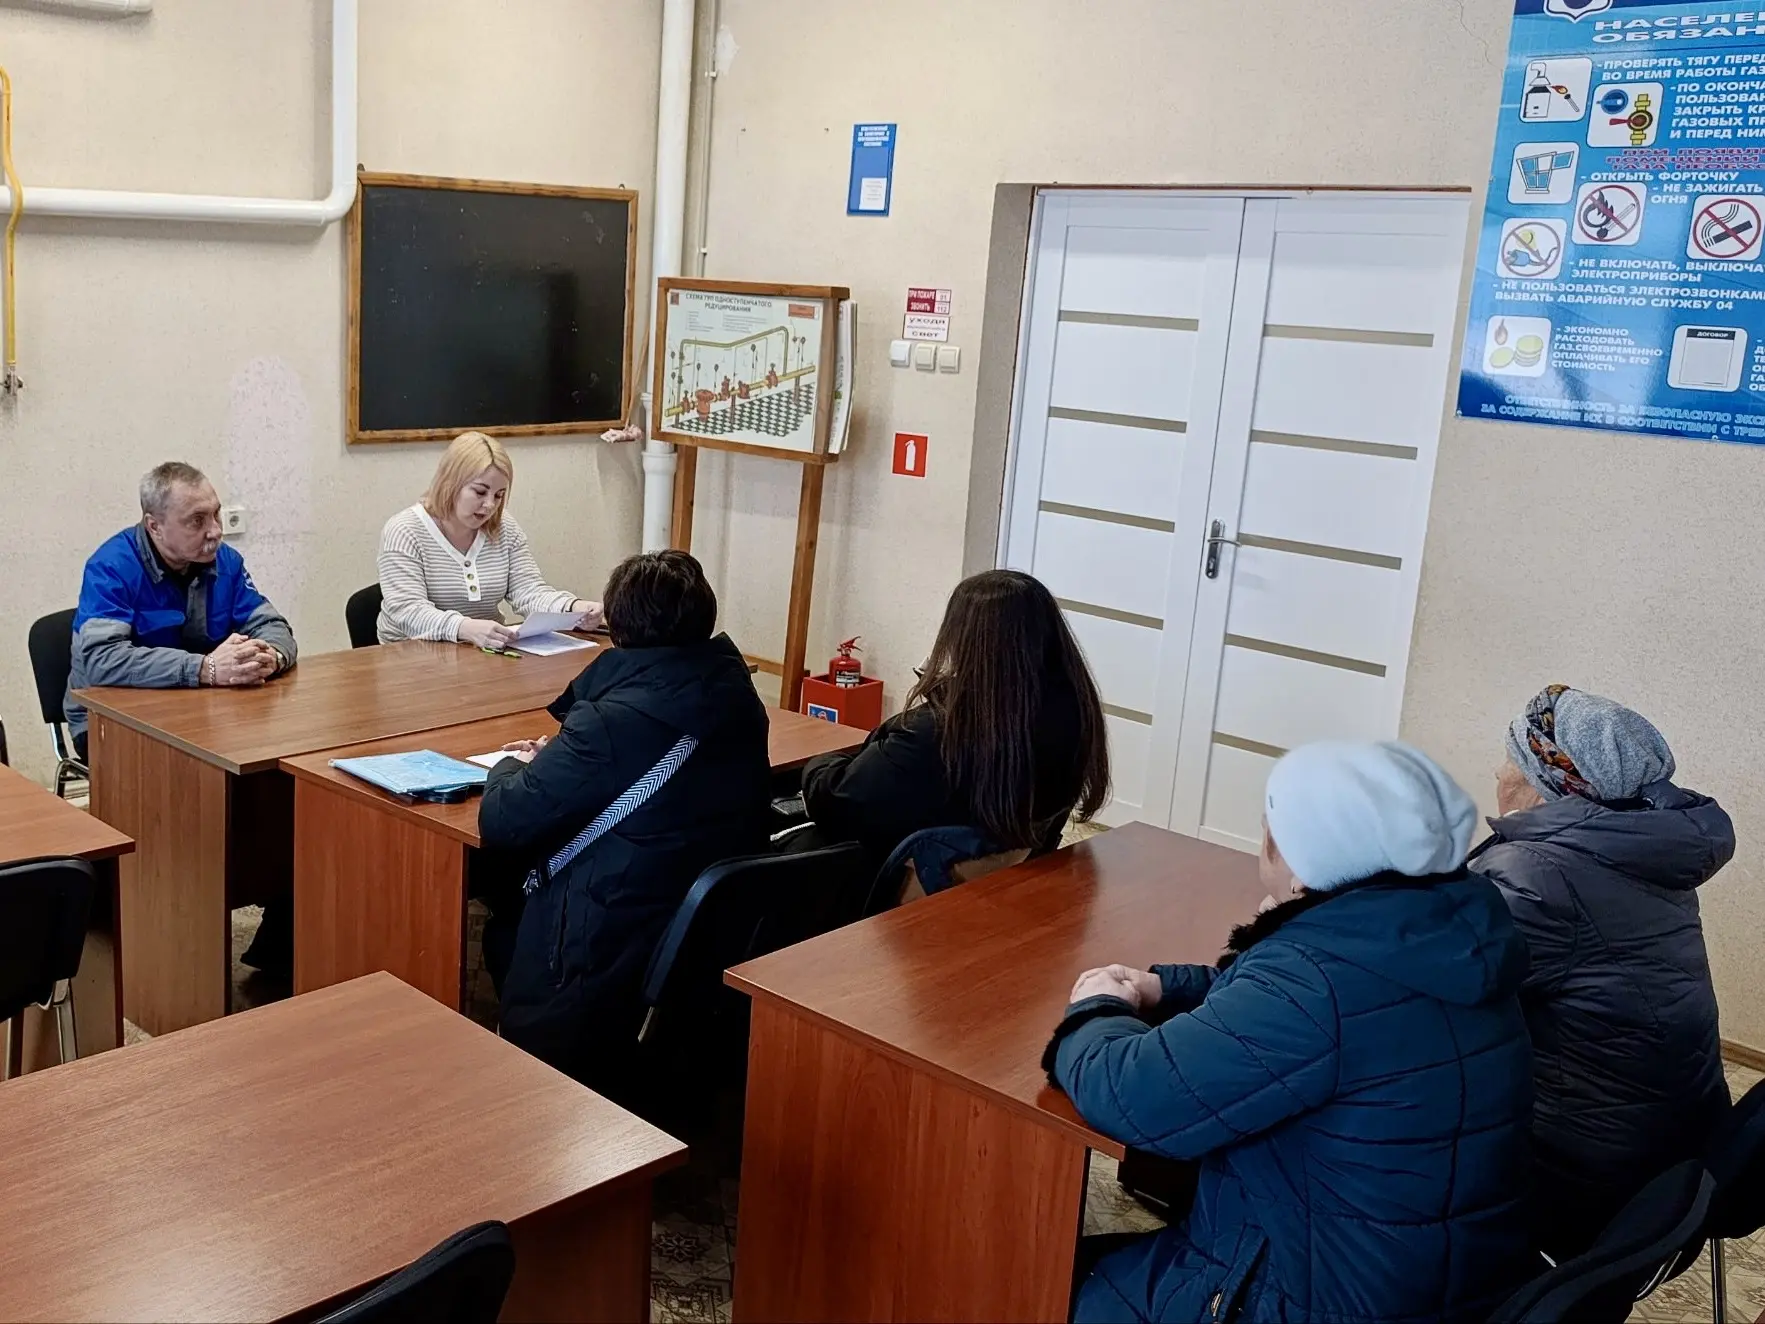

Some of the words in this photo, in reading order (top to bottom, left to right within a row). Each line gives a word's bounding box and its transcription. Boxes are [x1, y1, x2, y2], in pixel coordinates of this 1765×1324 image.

[1687, 55, 1720, 66] ТЯГУ
[1602, 71, 1622, 81] ВО
[1626, 68, 1671, 80] ВРЕМЯ
[1675, 66, 1736, 78] РАБОТЫ
[1673, 104, 1743, 116] ЗАКРЫТЬ
[1671, 116, 1743, 128] ГАЗОВЫХ
[1669, 129, 1681, 139] И
[1685, 128, 1732, 140] ПЕРЕД
[1590, 172, 1654, 182] ОТКРЫТЬ
[1658, 171, 1740, 182] ФОРТОЧКУ
[1663, 183, 1681, 194] НЕ
[1685, 183, 1764, 194] ЗАЖИГАТЬ
[1651, 194, 1688, 204] ОГНЯ
[1578, 258, 1596, 268] НЕ
[1599, 259, 1681, 272] ВКЛЮЧАТЬ,
[1685, 261, 1765, 273] ВЫКЛЮЧА
[1571, 269, 1702, 283] ЭЛЕКТРОПРИБОРЫ
[1501, 281, 1518, 290] НЕ
[1521, 282, 1626, 294] ПОЛЬЗОВАТЬСЯ
[1629, 286, 1765, 301] ЭЛЕКТРОЗВОНКАМ
[1495, 291, 1554, 303] ВЫЗВАТЬ
[1557, 293, 1647, 306] АВАРИЙНУЮ
[1650, 298, 1713, 310] СЛУЖБУ
[1715, 300, 1733, 311] 04
[1563, 325, 1629, 337] ЭКОНОМНО
[1554, 334, 1635, 346] РАСХОДОВАТЬ
[1552, 351, 1627, 364] ОПЛАЧИВАТЬ
[1551, 360, 1616, 372] СТОИМОСТЬ
